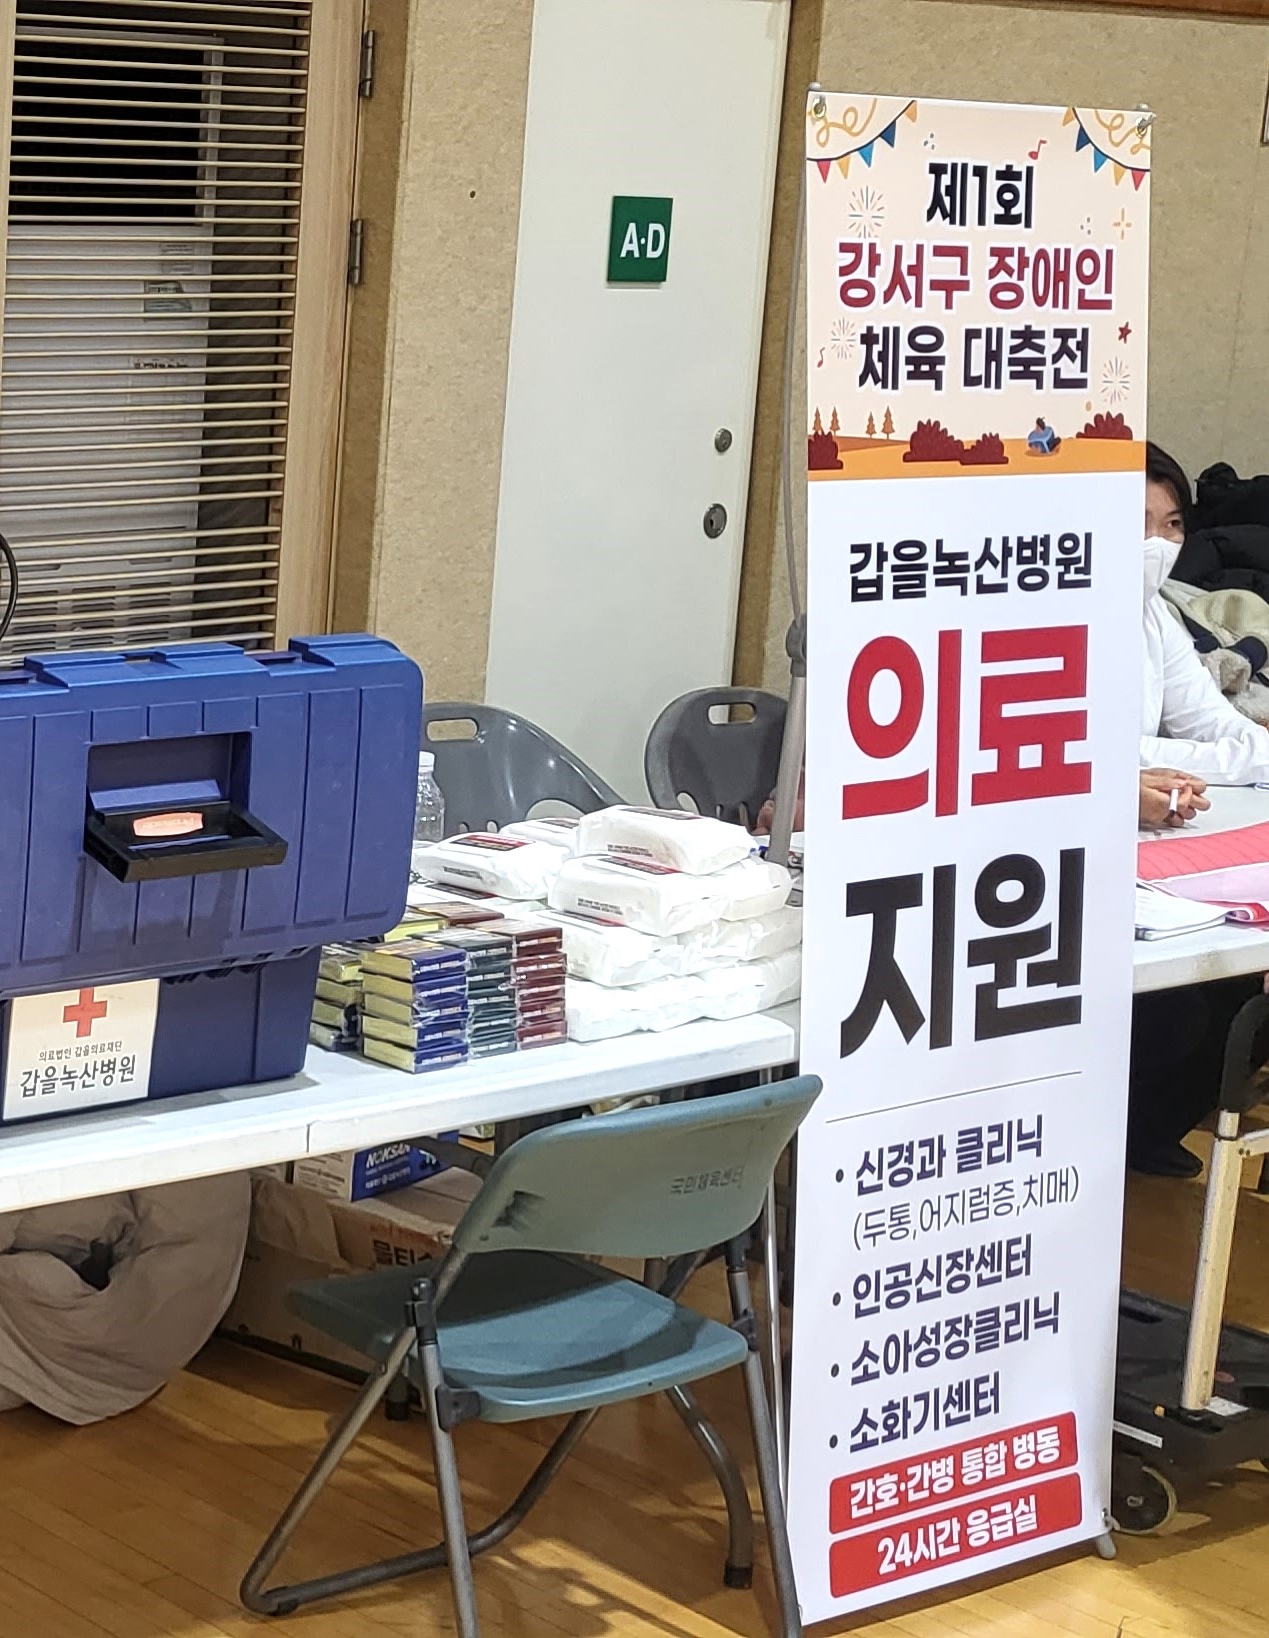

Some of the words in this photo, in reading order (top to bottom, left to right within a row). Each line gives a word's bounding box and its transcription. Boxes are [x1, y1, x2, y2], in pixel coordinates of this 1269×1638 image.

[926, 162, 1034, 229] 제1회
[838, 241, 970, 311] 강서구
[987, 245, 1114, 311] 장애인
[858, 325, 946, 391] 체육
[963, 325, 1090, 391] 대축전
[849, 532, 1092, 603] 갑을녹산병원
[842, 623, 1093, 820] 의료
[840, 847, 1086, 1059] 지원
[20, 1054, 136, 1098] 갑을녹산병원
[38, 1046, 72, 1062] 의료법인
[75, 1040, 123, 1057] 갑을의료재단
[856, 1134, 947, 1197] 신경과
[956, 1114, 1043, 1174] 클리닉
[852, 1232, 1032, 1319] 인공신장센터
[850, 1291, 1060, 1386] 소아성장클리닉
[849, 1370, 1000, 1453] 소화기센터
[961, 1440, 1008, 1486] 통합
[1012, 1426, 1061, 1470] 병동
[877, 1516, 961, 1575] 24시간
[965, 1494, 1039, 1547] 응급실
